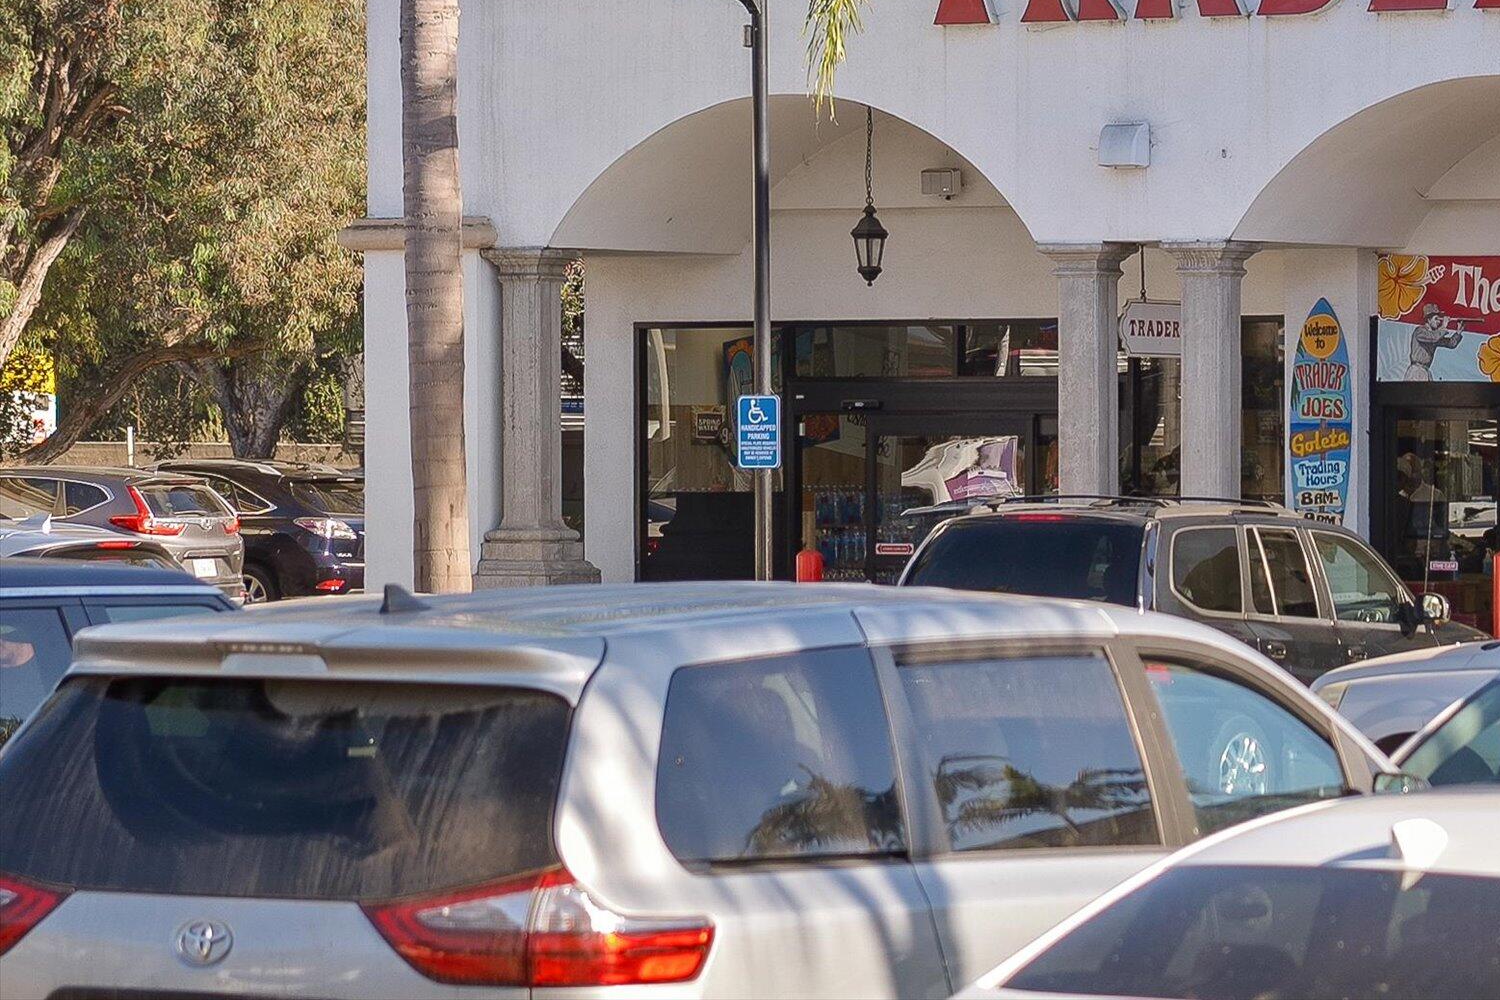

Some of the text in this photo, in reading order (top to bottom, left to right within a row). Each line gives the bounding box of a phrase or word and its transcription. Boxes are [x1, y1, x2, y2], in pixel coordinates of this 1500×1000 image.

[1128, 319, 1181, 338] TRADER
[1303, 321, 1338, 337] Welcome
[1314, 338, 1326, 349] to
[1295, 362, 1346, 390] TRADER
[1300, 397, 1344, 419] JOES
[747, 432, 771, 440] PARKING
[1291, 428, 1350, 457] Goleta
[1298, 461, 1341, 475] Trading
[1306, 475, 1338, 486] Hours
